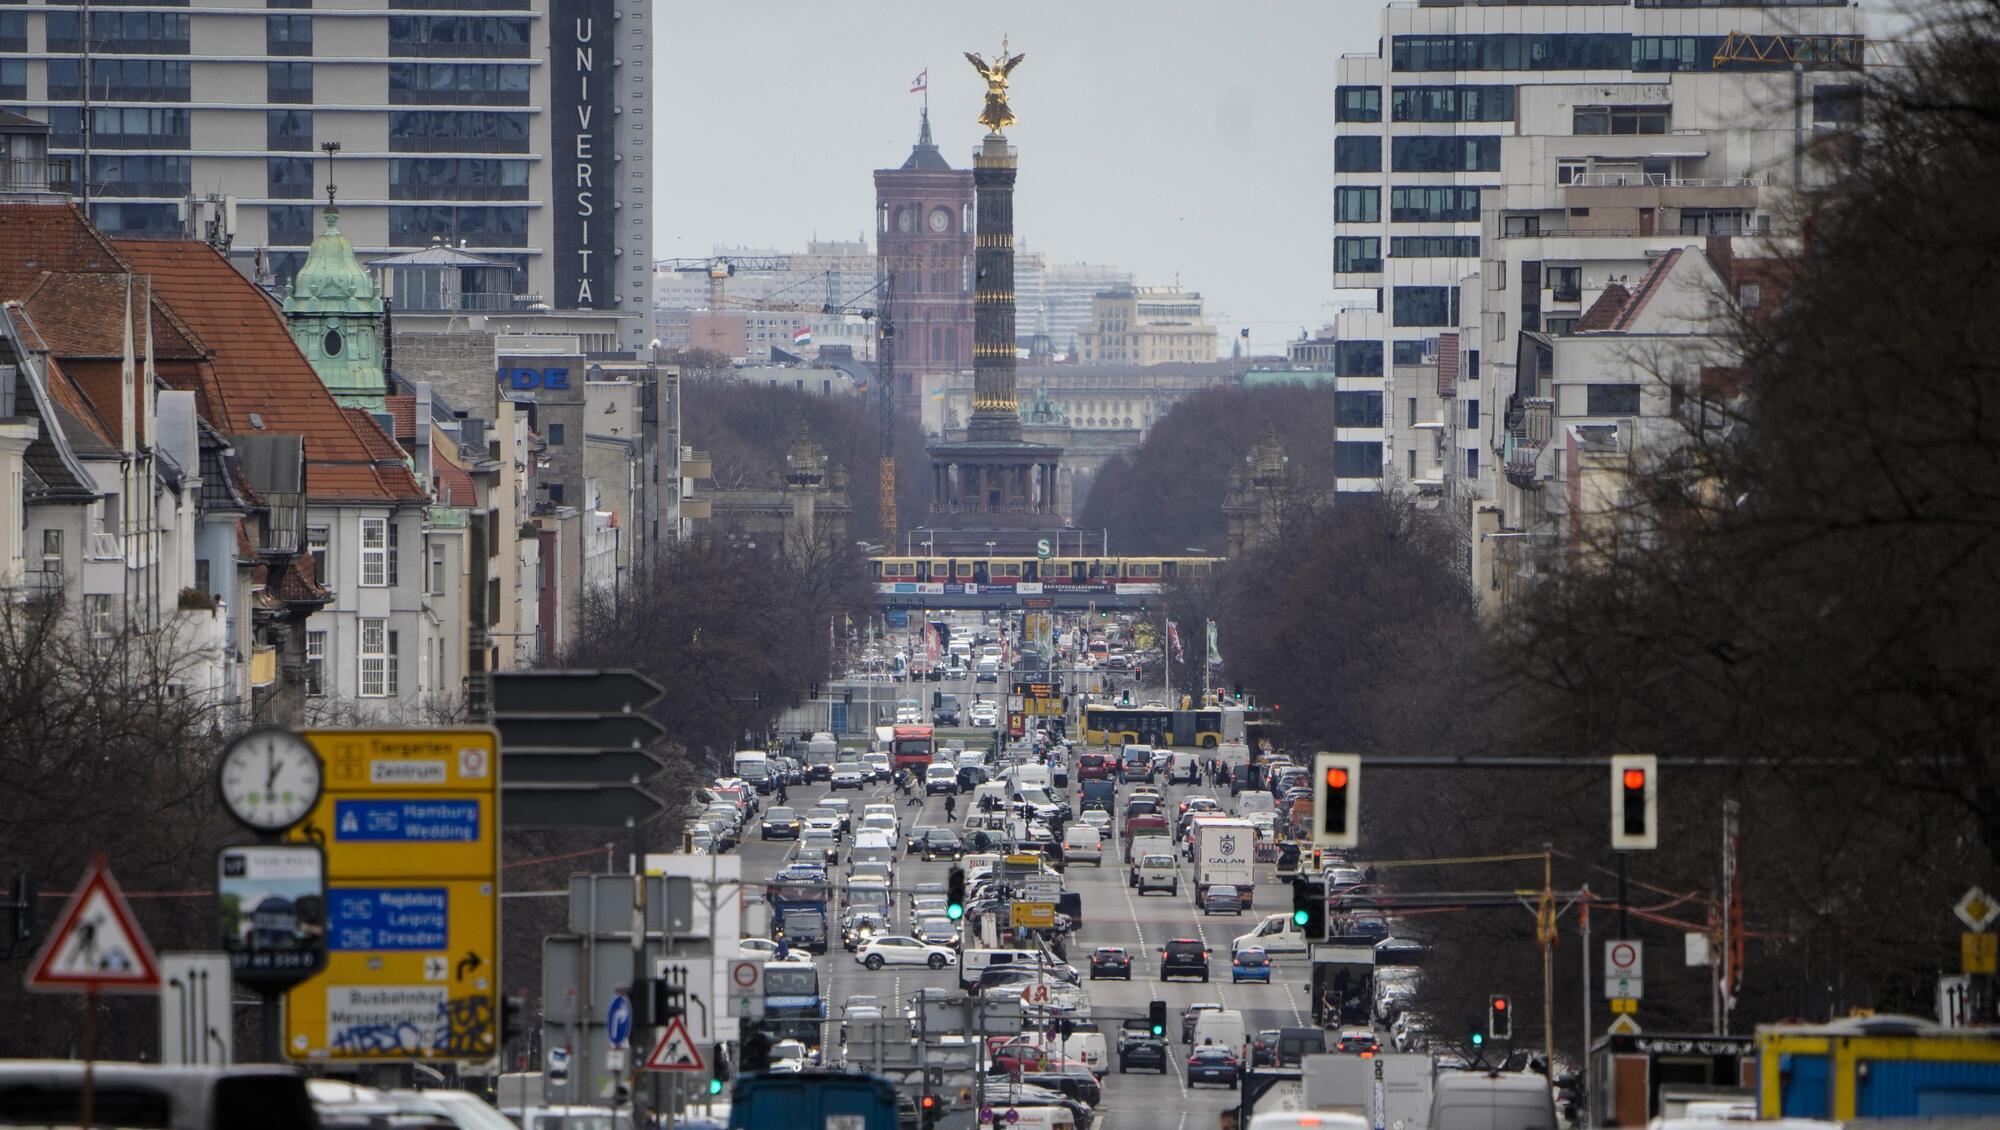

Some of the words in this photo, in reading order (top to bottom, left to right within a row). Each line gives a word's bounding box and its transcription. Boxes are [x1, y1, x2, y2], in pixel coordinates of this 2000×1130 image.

[576, 18, 593, 310] UNIVERSITÄ
[1037, 540, 1050, 555] S
[371, 738, 452, 757] Tiergarten
[375, 763, 441, 779] Zentrum
[403, 805, 476, 823] Hamburg
[405, 824, 472, 841] Wedding
[379, 892, 445, 910] Magdeburg
[388, 912, 444, 928] Leipzig
[379, 929, 444, 945] Dresden
[351, 989, 444, 1005] Busbahnhof
